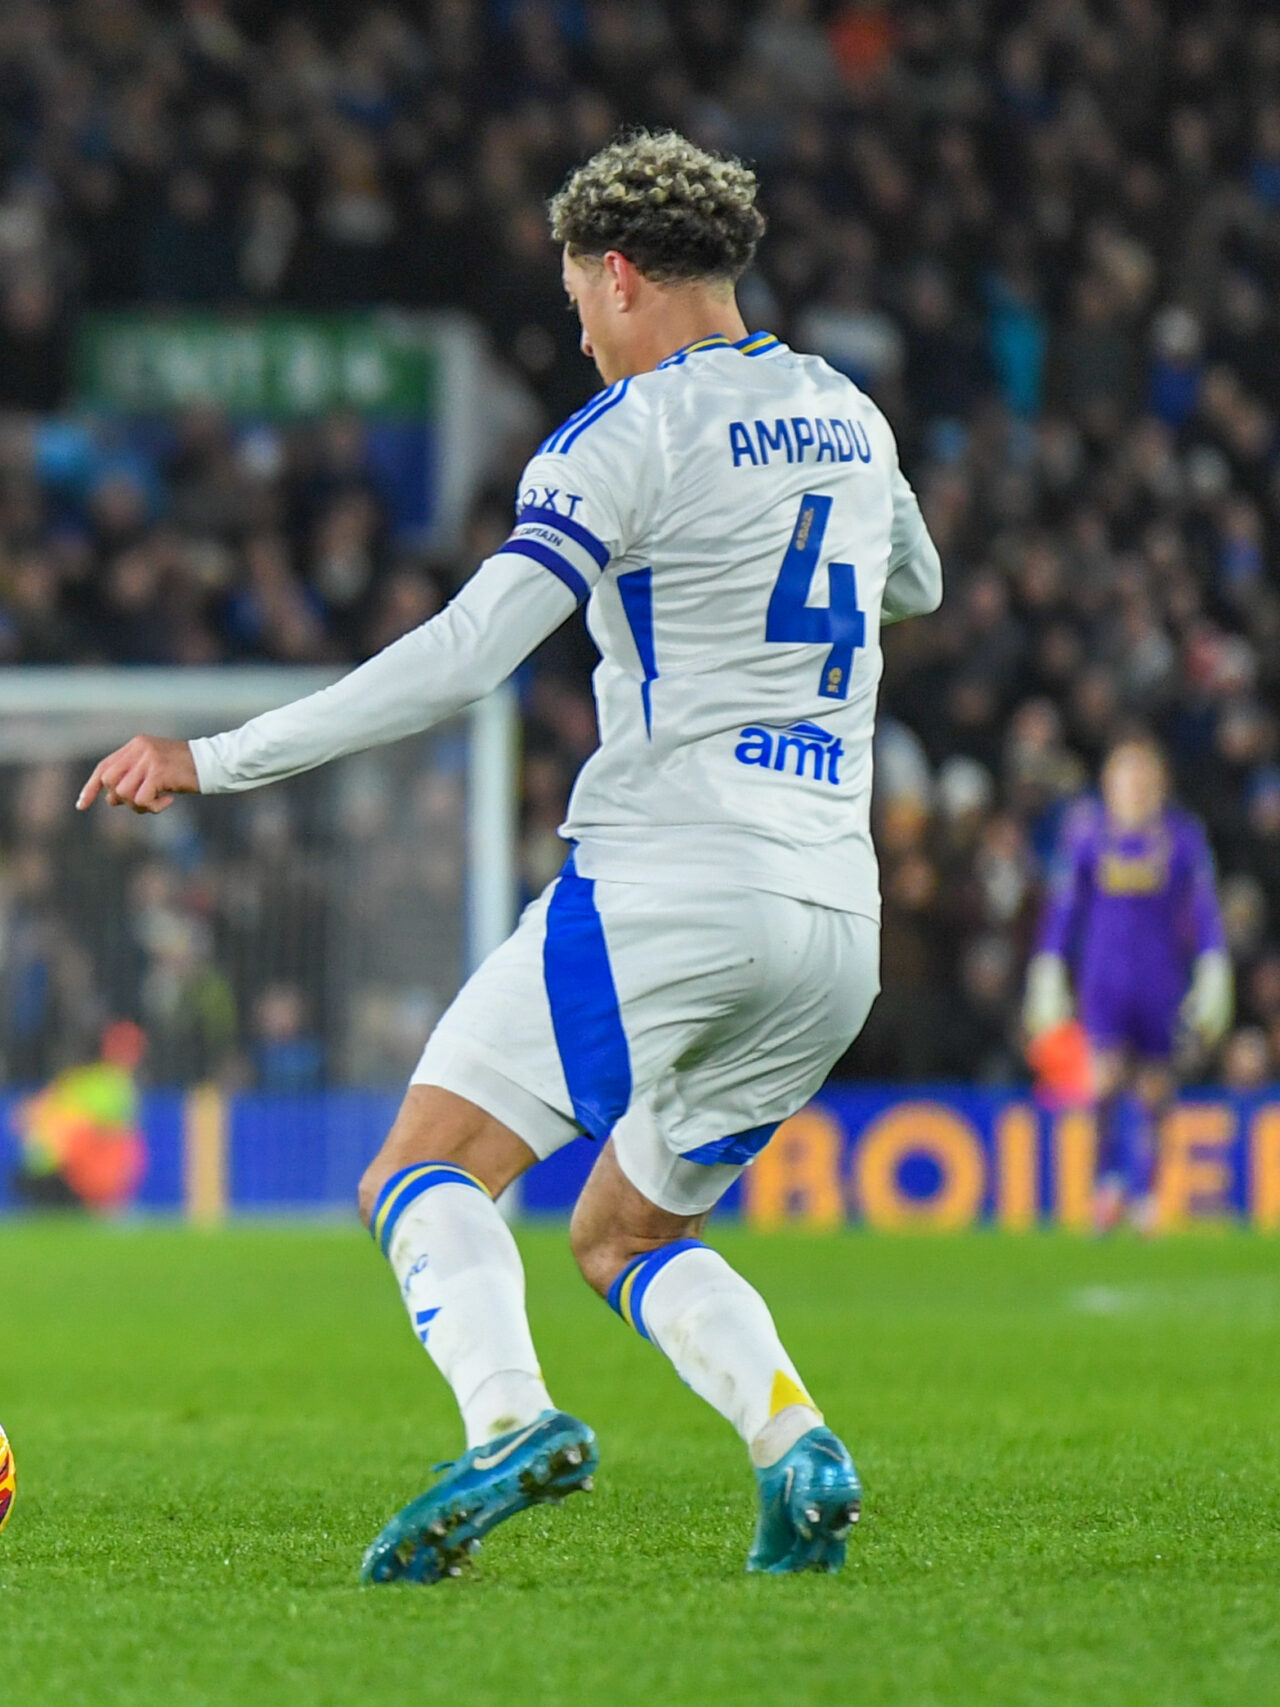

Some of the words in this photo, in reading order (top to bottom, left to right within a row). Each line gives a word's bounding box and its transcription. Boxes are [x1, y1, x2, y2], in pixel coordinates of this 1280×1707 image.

[729, 417, 872, 467] AMPADU
[519, 527, 564, 547] CAPTAIN
[765, 494, 865, 700] 4
[734, 726, 845, 785] amt
